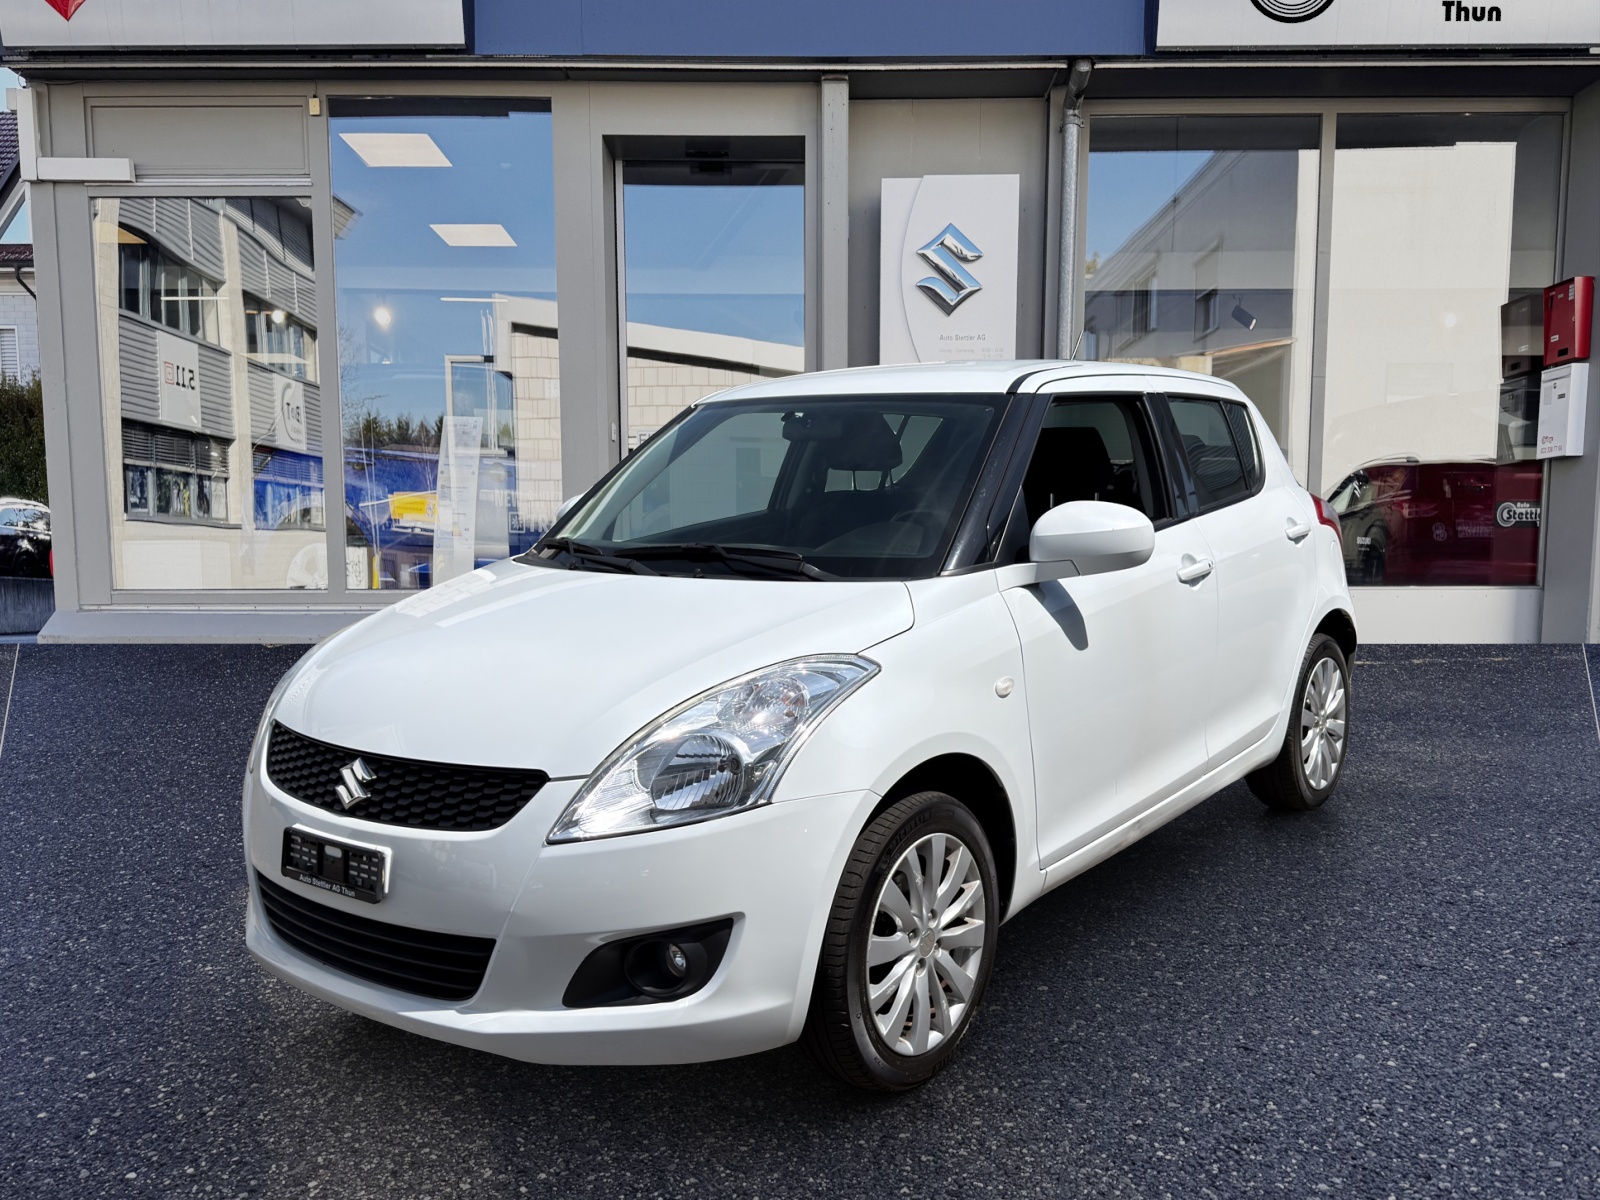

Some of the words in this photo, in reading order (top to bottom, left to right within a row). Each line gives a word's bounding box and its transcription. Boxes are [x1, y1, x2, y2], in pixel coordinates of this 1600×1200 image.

[1442, 1, 1502, 22] Thun
[300, 874, 312, 884] Auto
[312, 877, 331, 890] Stettler
[332, 883, 341, 893] AG
[341, 886, 356, 897] Thun
